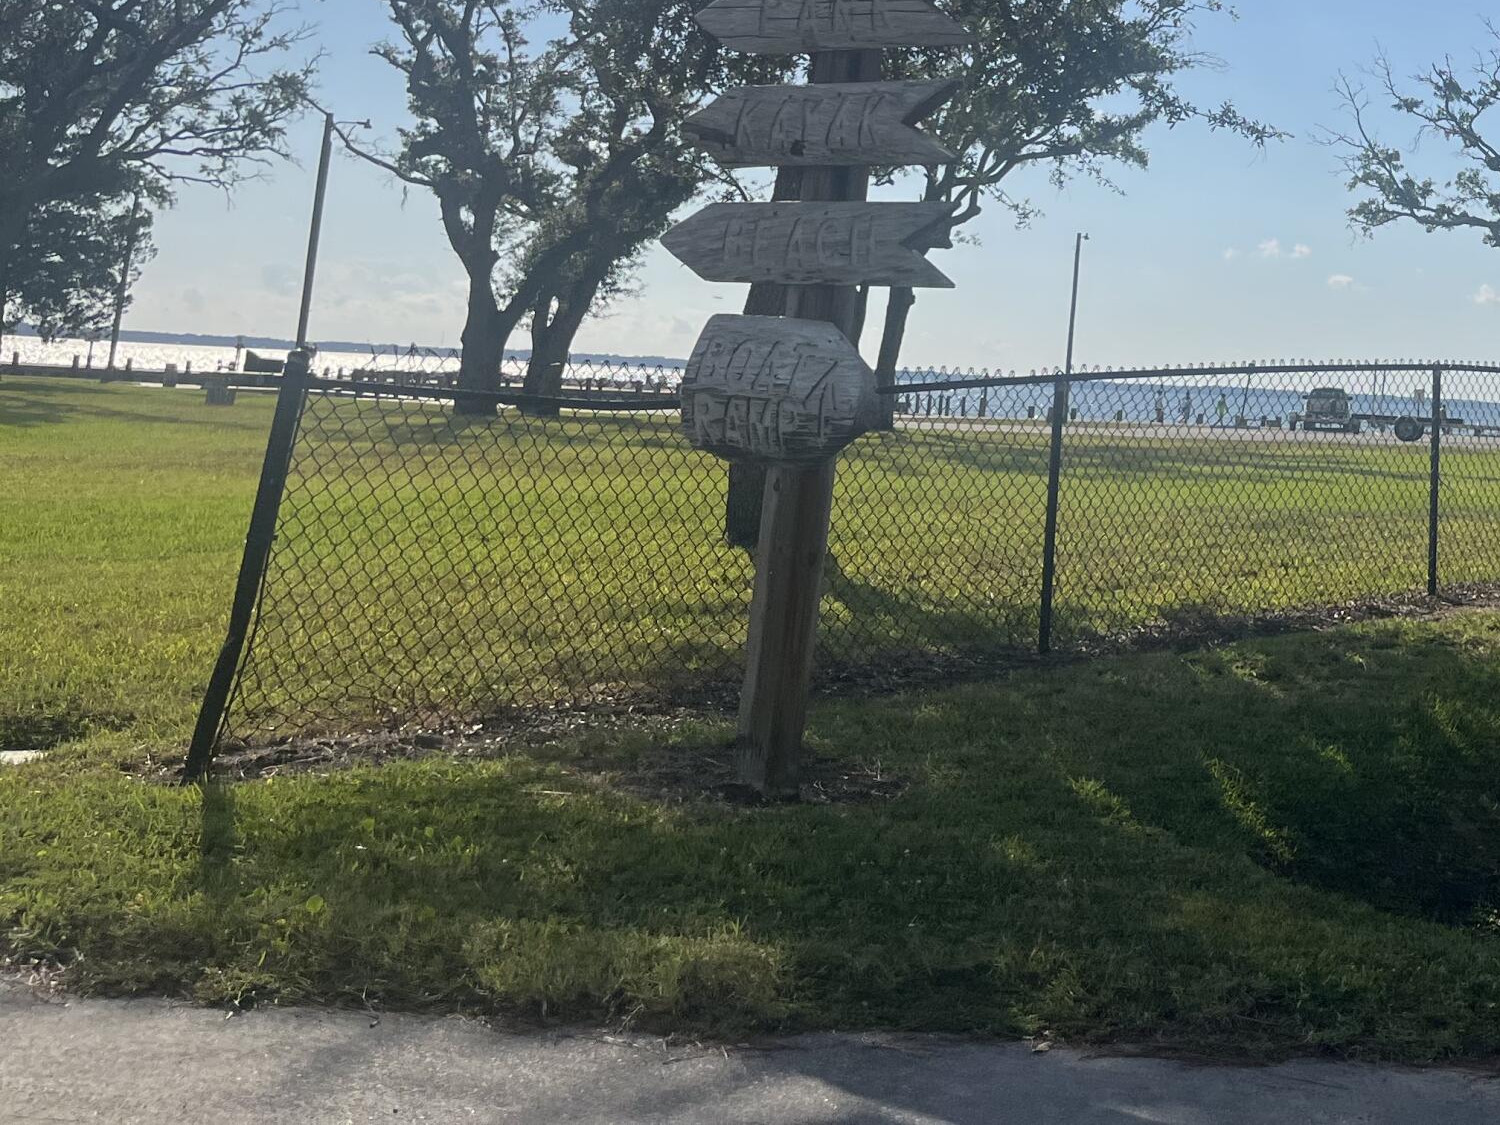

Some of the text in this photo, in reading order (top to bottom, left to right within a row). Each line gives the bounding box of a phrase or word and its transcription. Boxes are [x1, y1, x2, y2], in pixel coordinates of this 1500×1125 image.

[734, 94, 888, 150] KAYAK
[722, 215, 877, 268] BEACH
[695, 339, 819, 394] BOAT
[691, 392, 798, 455] RAMP
